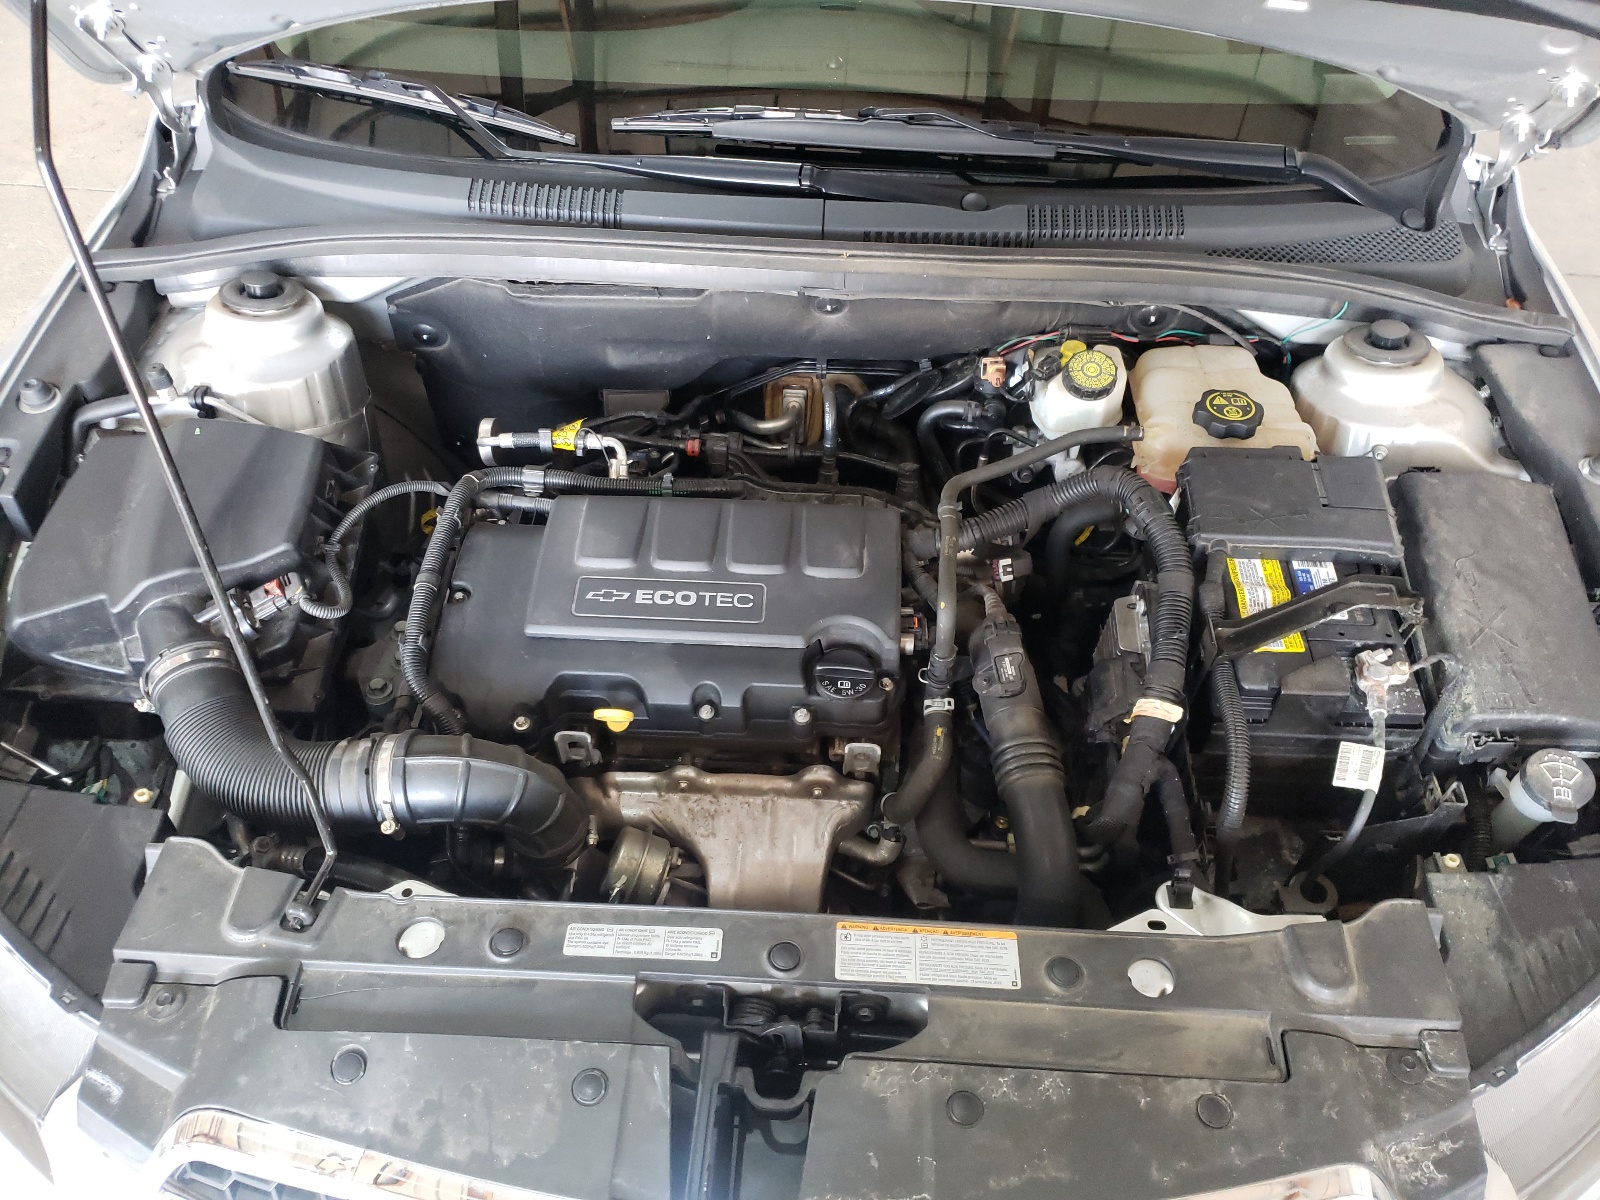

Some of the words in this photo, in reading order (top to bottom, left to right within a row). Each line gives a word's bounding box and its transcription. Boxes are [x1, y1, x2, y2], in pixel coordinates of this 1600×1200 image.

[634, 589, 754, 608] ECOTEC
[821, 680, 837, 693] SAE
[841, 683, 867, 696] 5W-30
